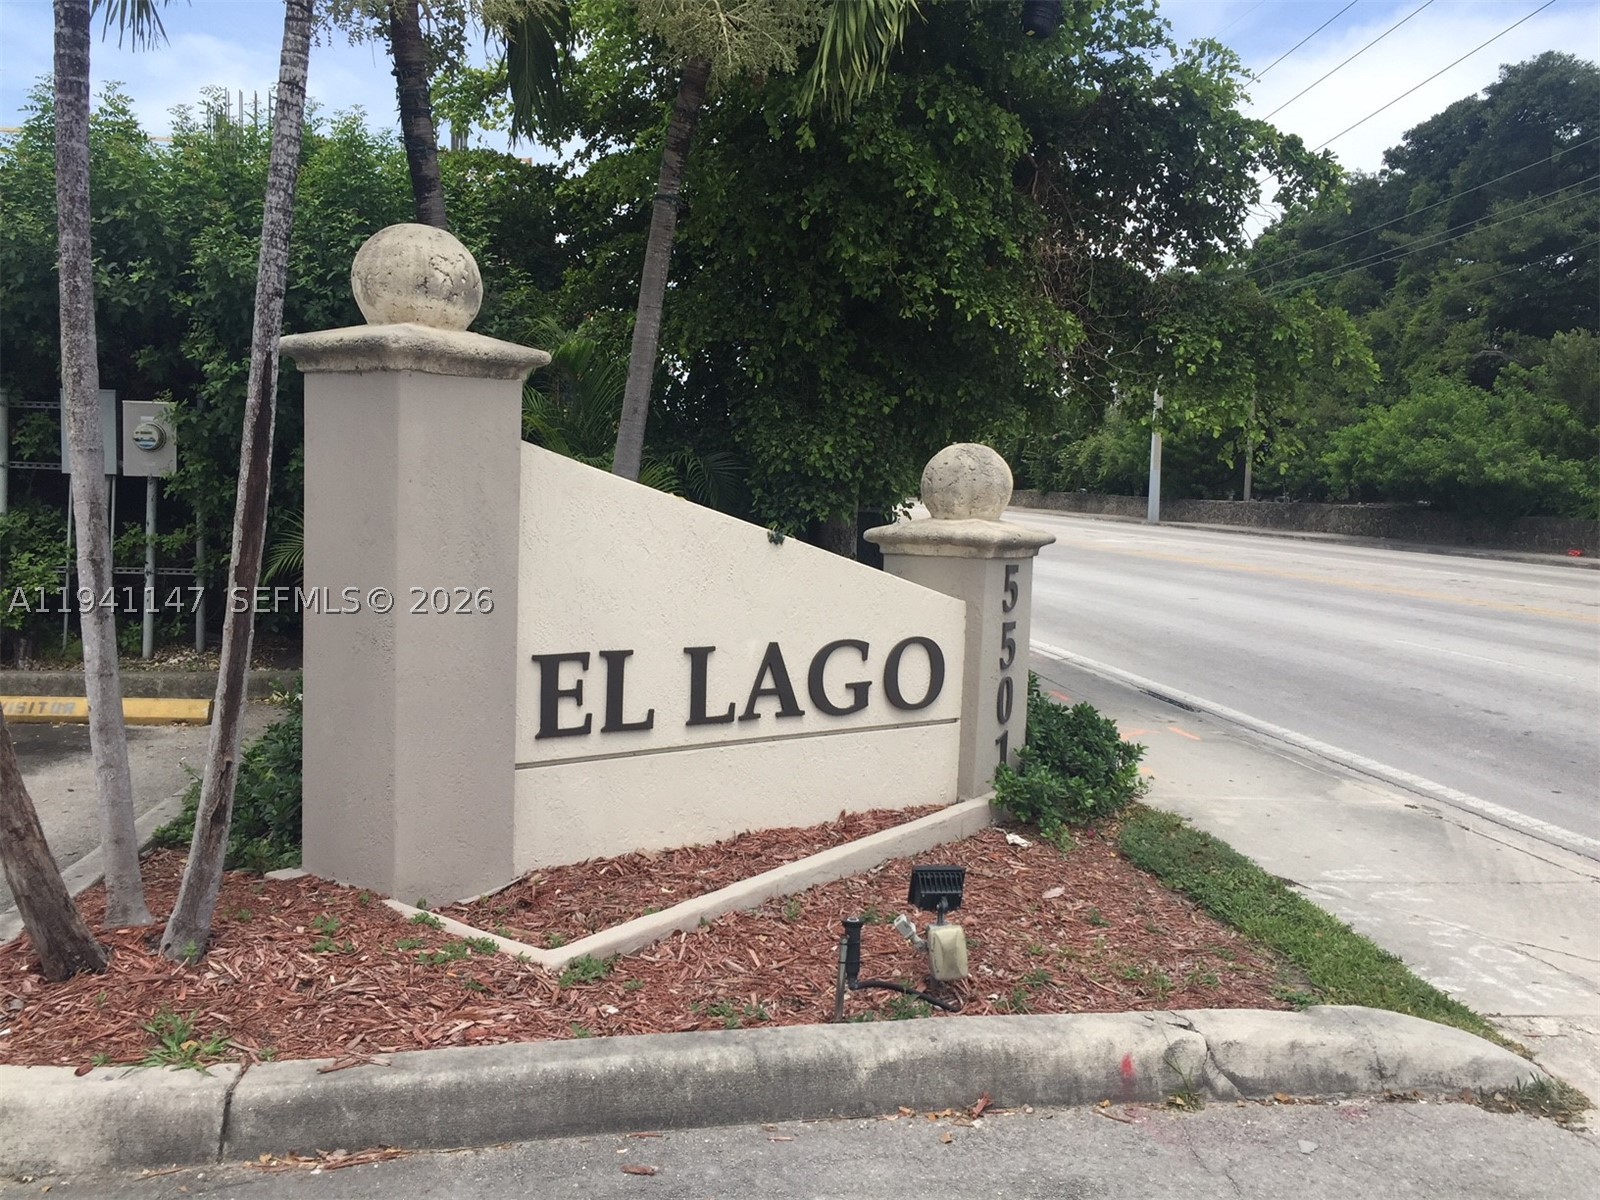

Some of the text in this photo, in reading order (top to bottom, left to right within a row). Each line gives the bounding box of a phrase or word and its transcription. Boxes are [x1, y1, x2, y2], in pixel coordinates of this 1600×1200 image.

[532, 636, 945, 740] EL LAGO
[995, 564, 1019, 764] 5501
